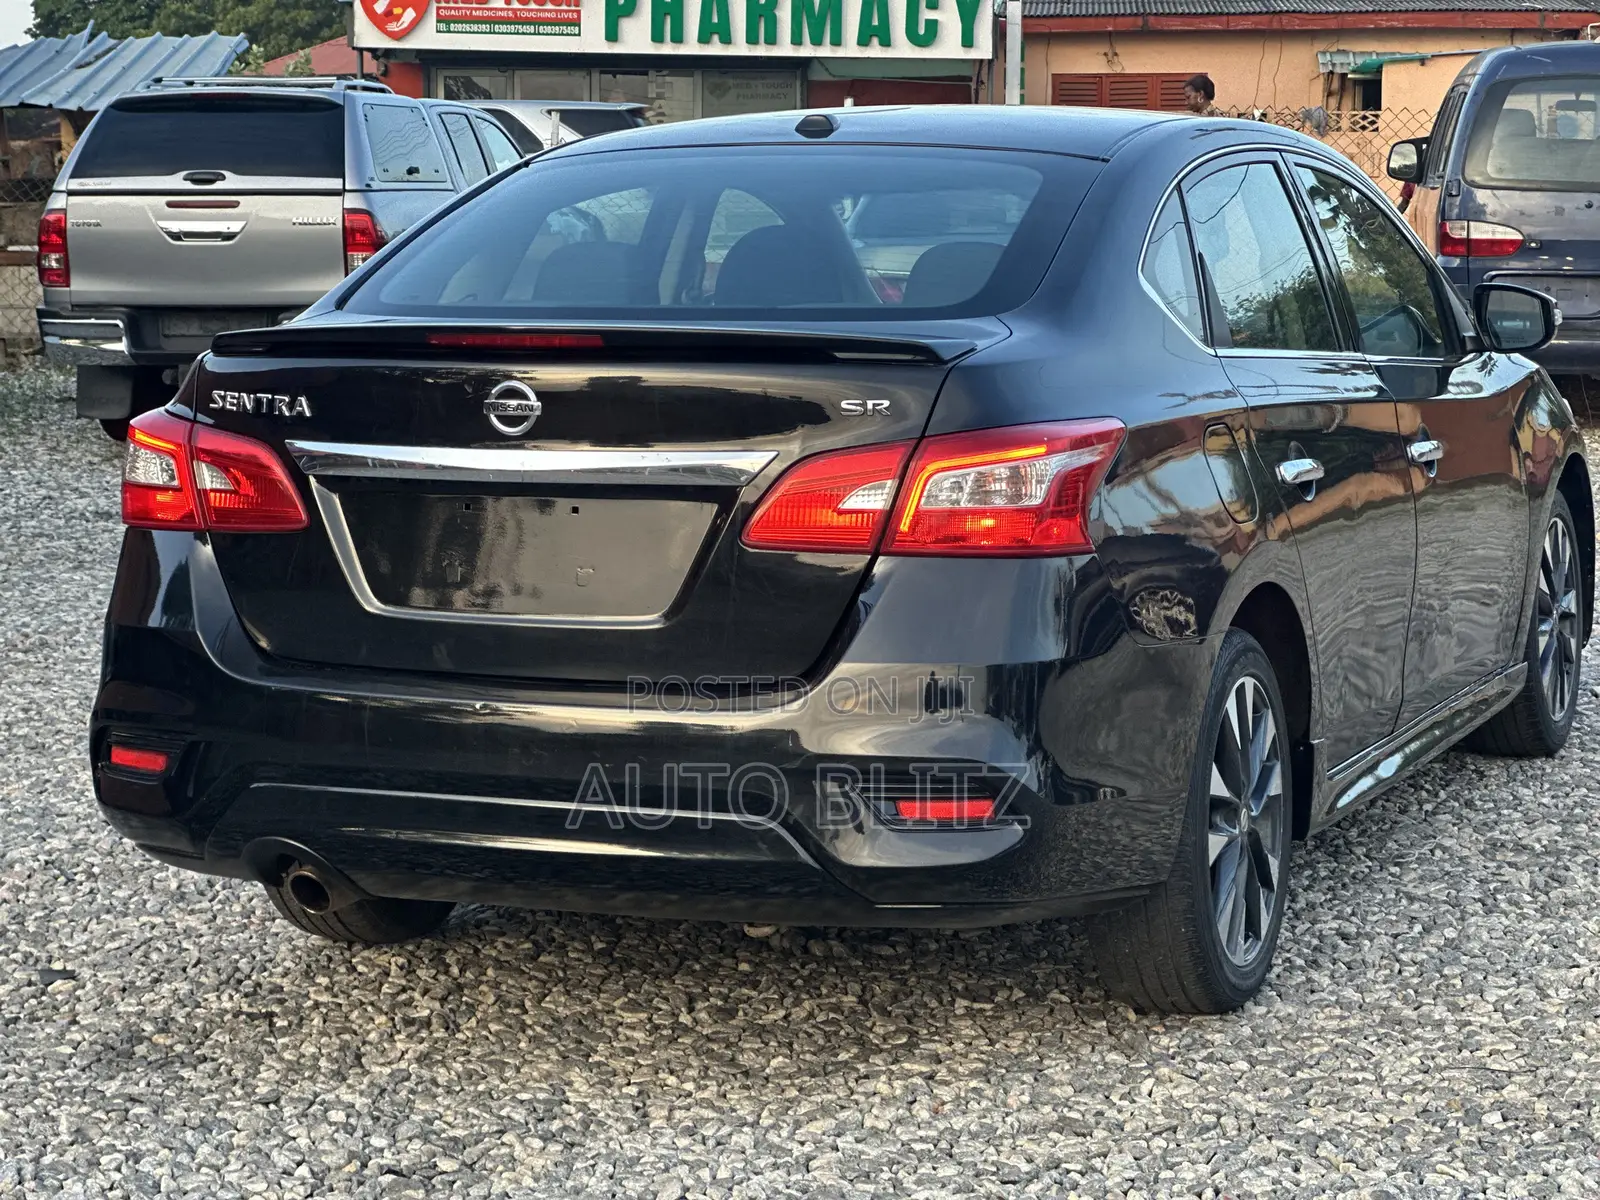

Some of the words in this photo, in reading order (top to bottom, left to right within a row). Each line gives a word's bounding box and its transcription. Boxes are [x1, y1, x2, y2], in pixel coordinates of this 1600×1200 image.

[472, 10, 515, 18] MEDICINES,
[437, 23, 449, 31] TEL:
[605, 0, 982, 48] PHARMACY
[70, 220, 102, 228] TOYOTA
[292, 216, 338, 226] HILUX
[209, 390, 312, 417] SENTRA
[488, 402, 534, 412] NISSAN
[840, 399, 892, 416] SR
